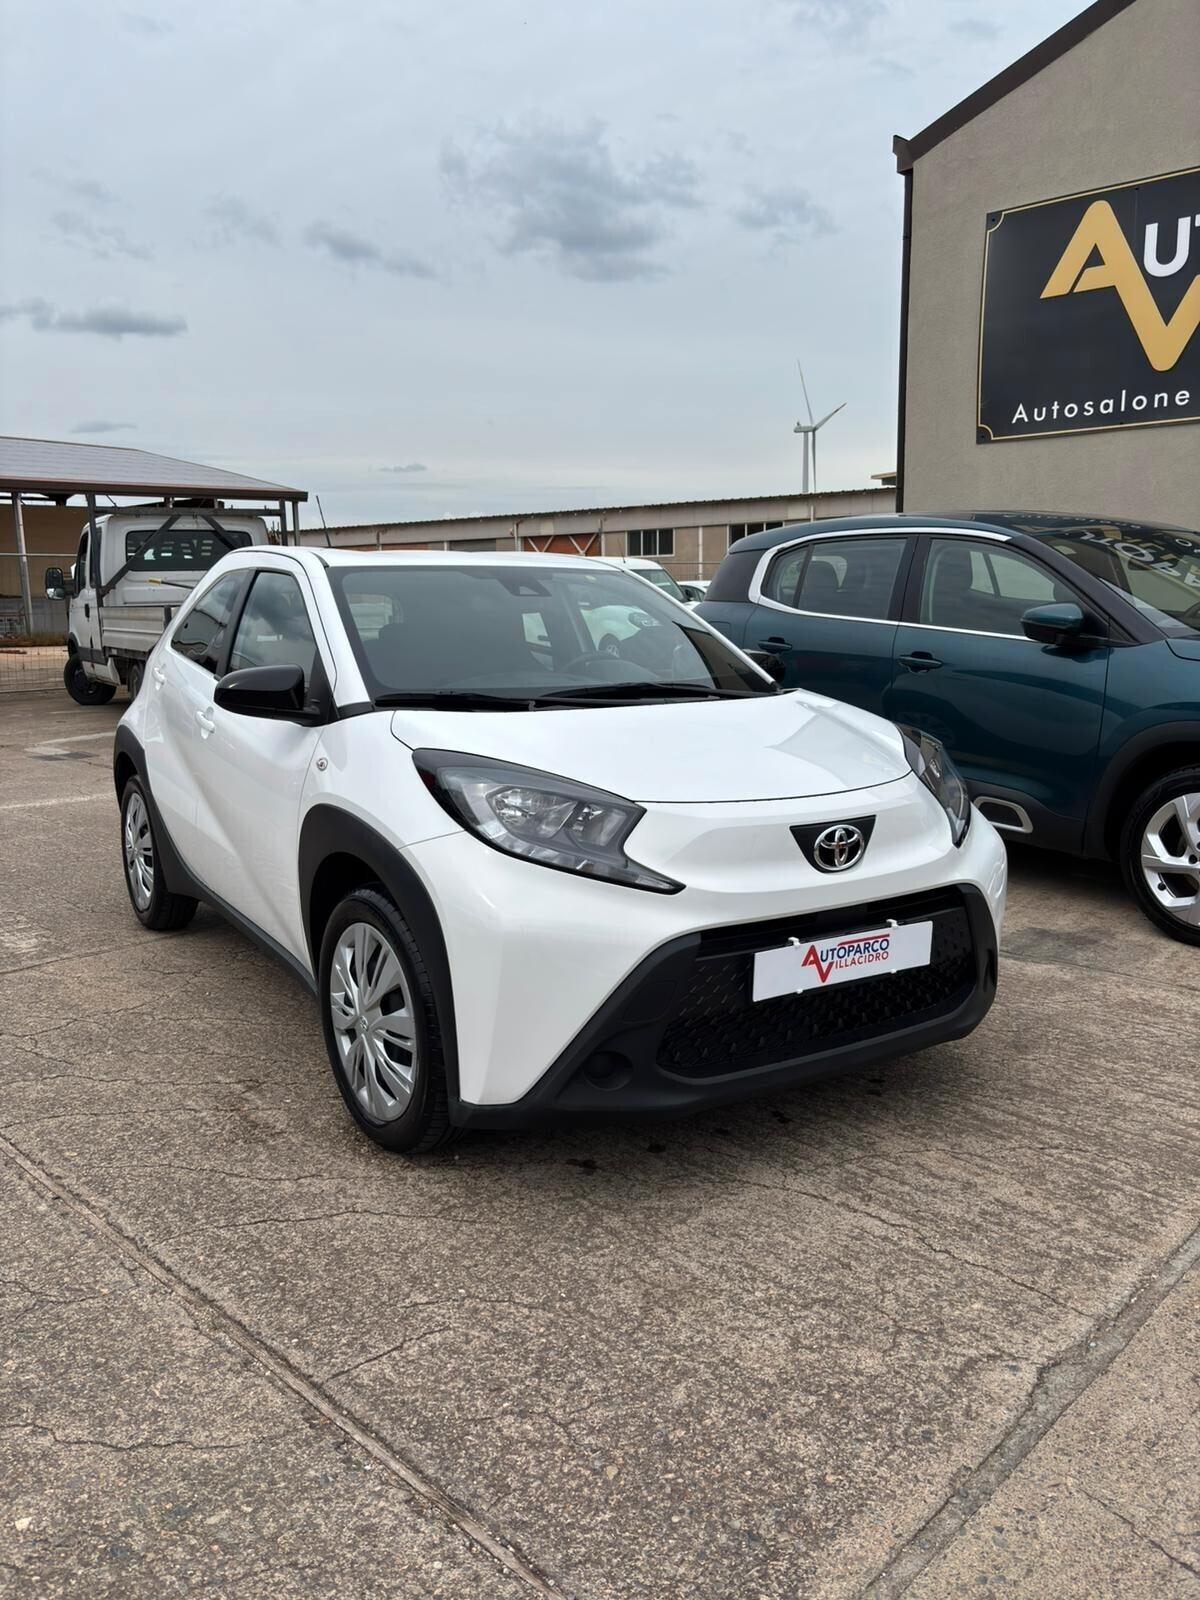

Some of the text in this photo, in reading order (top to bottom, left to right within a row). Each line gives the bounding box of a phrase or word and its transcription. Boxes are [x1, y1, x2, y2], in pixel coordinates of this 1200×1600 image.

[1011, 389, 1191, 424] Autosalone
[801, 938, 890, 967] AUTOPARCO
[816, 950, 889, 983] VILLACIDRO
